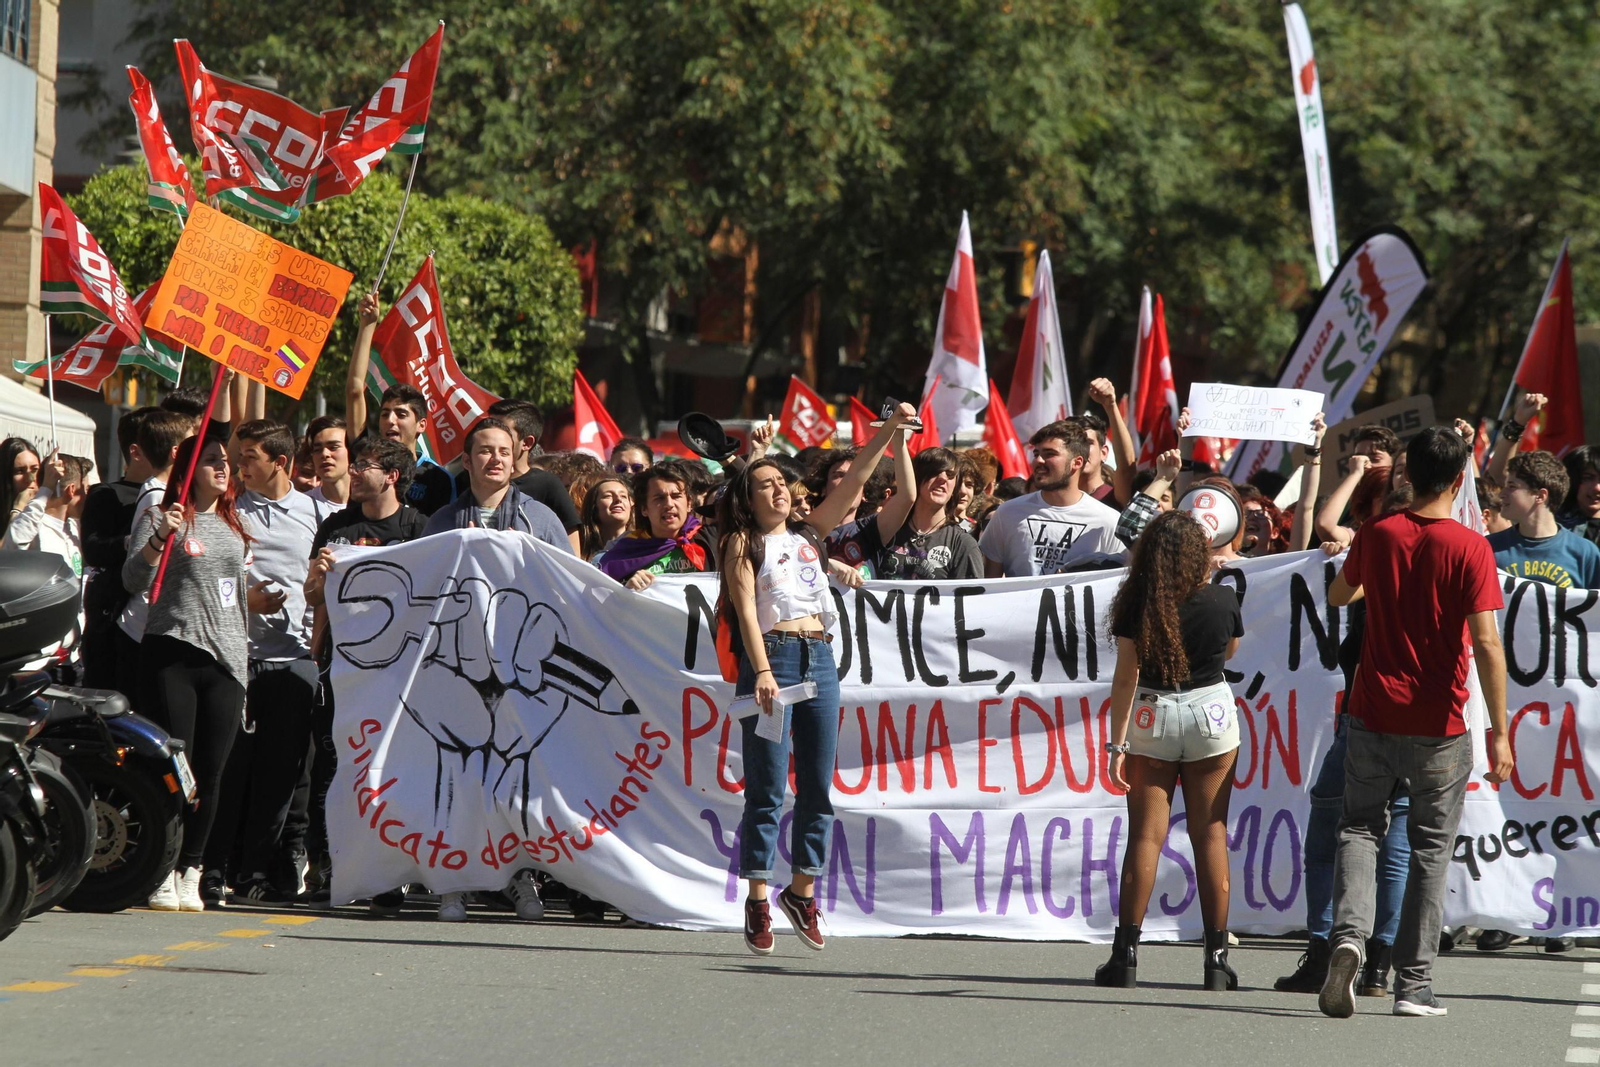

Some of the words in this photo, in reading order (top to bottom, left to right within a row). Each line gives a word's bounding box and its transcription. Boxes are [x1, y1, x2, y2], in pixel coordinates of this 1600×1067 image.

[179, 229, 245, 276] CARRERA
[244, 260, 268, 288] EN
[267, 273, 338, 319] ESPAÑA
[192, 206, 217, 233] SI
[220, 219, 283, 265] ACABAS
[288, 255, 330, 287] UNA
[172, 252, 239, 300] TIENES
[239, 287, 259, 314] 3
[259, 298, 329, 344] SALIDAS
[174, 284, 209, 317] POR
[162, 310, 206, 348] MAR
[210, 334, 226, 355] O
[226, 344, 269, 383] AIRE.
[1035, 547, 1067, 561] WEST
[1044, 560, 1055, 569] 83
[1524, 560, 1573, 588] BASKETB
[1031, 584, 1098, 682] NI
